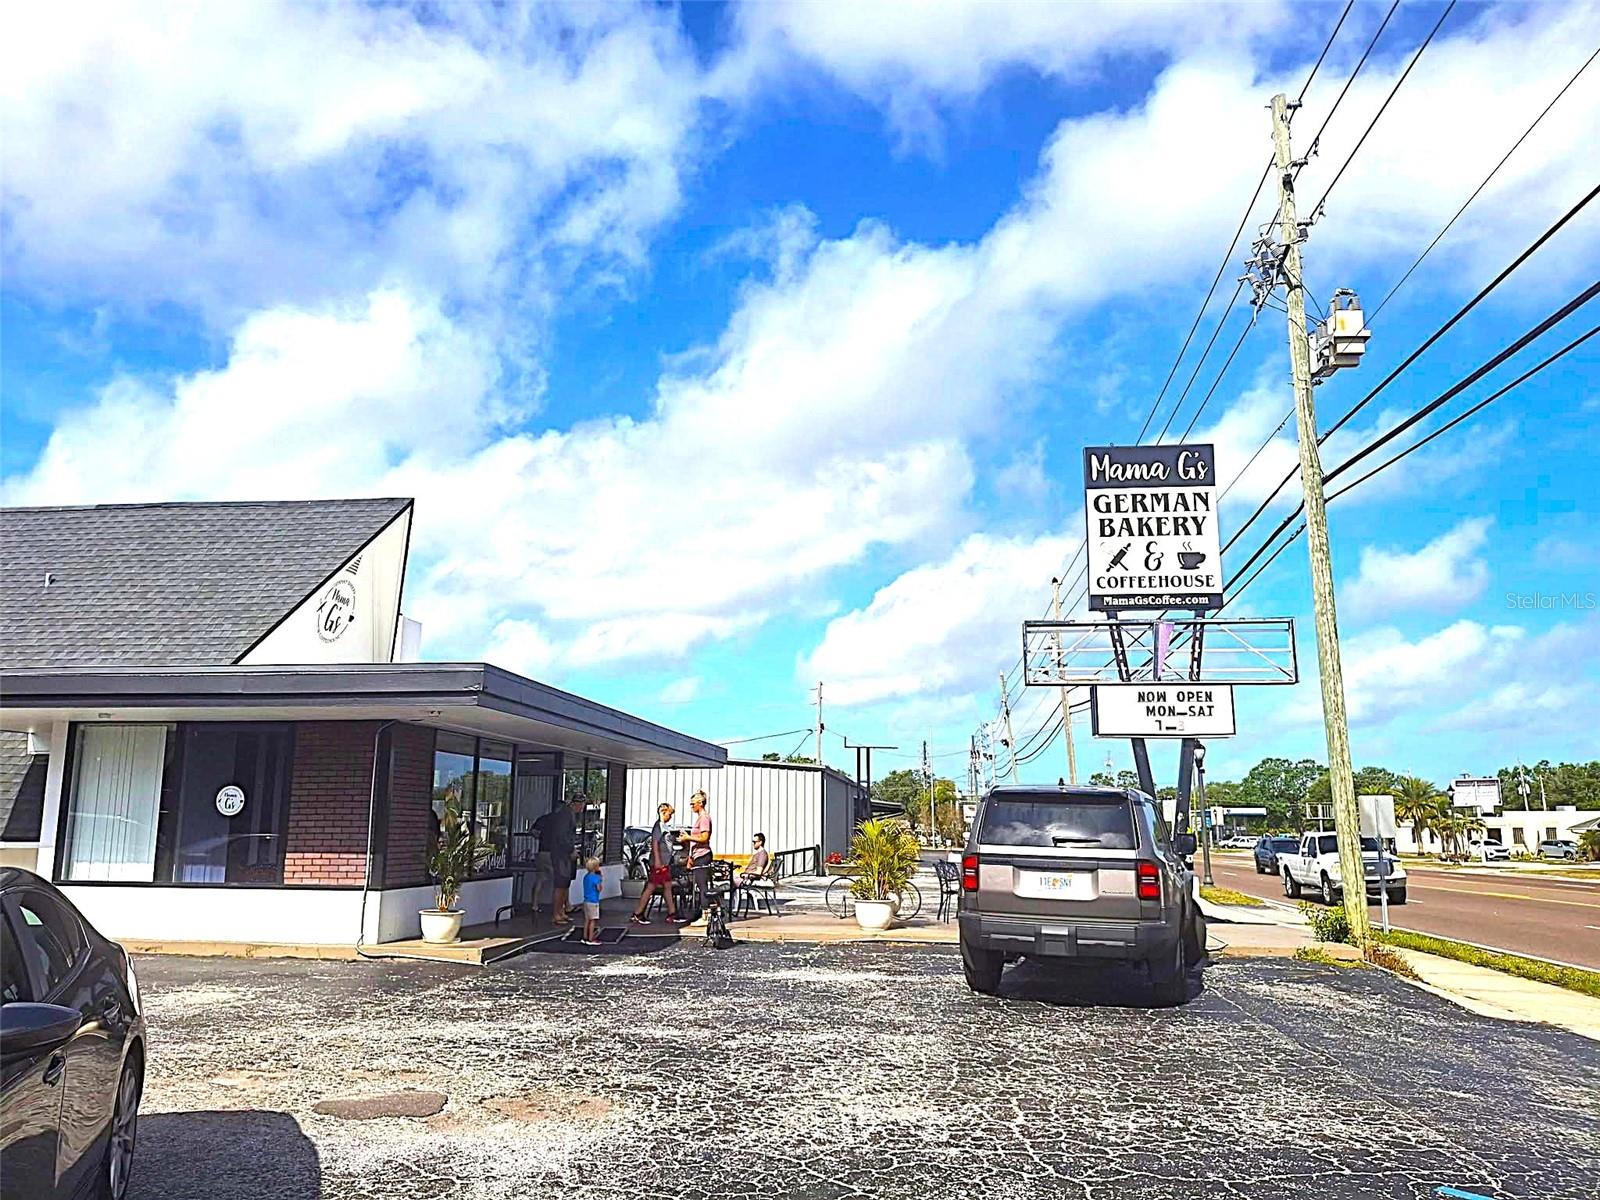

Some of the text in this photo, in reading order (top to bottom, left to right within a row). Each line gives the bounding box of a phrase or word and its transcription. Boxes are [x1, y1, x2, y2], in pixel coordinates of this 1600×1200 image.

[1090, 451, 1208, 482] Mama G's
[1093, 492, 1210, 514] GERMAN
[1098, 516, 1207, 537] BAKERY
[1144, 541, 1164, 571] &
[1096, 574, 1215, 589] COFFEEHOUSE
[1103, 595, 1209, 606] MamaGsCoffee.com
[1137, 691, 1213, 703] NOW OPEN
